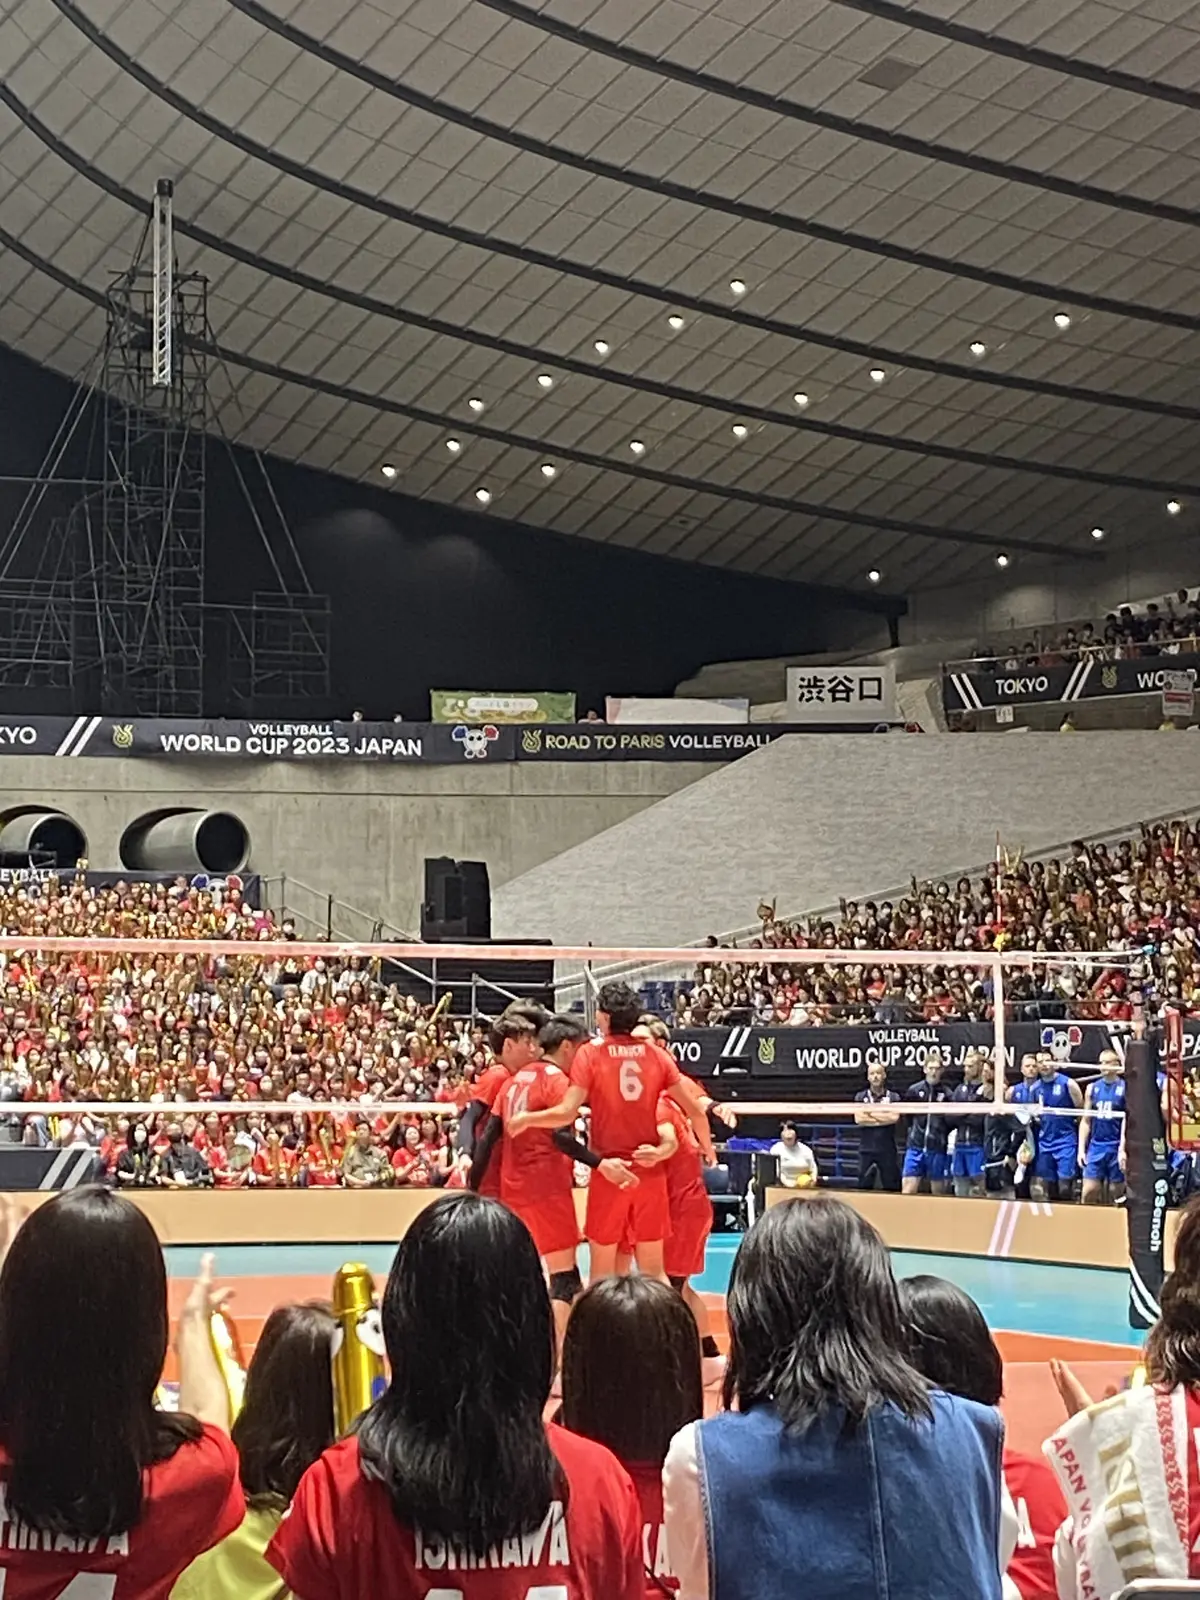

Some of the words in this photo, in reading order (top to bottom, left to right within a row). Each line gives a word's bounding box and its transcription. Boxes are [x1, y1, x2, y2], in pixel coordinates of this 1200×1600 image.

[798, 675, 882, 704] 渋谷口
[995, 676, 1048, 695] TOKYO
[249, 723, 333, 737] VOLLEYBALL
[160, 734, 241, 752] WORLD
[246, 737, 289, 754] CUP
[293, 738, 350, 755] 2023
[354, 738, 422, 756] JAPAN
[545, 734, 591, 749] ROAD
[596, 734, 616, 749] TO
[620, 734, 665, 749] PARIS
[868, 1028, 939, 1043] VOLLEYBALL
[796, 1048, 862, 1069] WORLD
[865, 1047, 901, 1068] CUP
[619, 1060, 642, 1101] 6
[1150, 1195, 1166, 1252] Senoh
